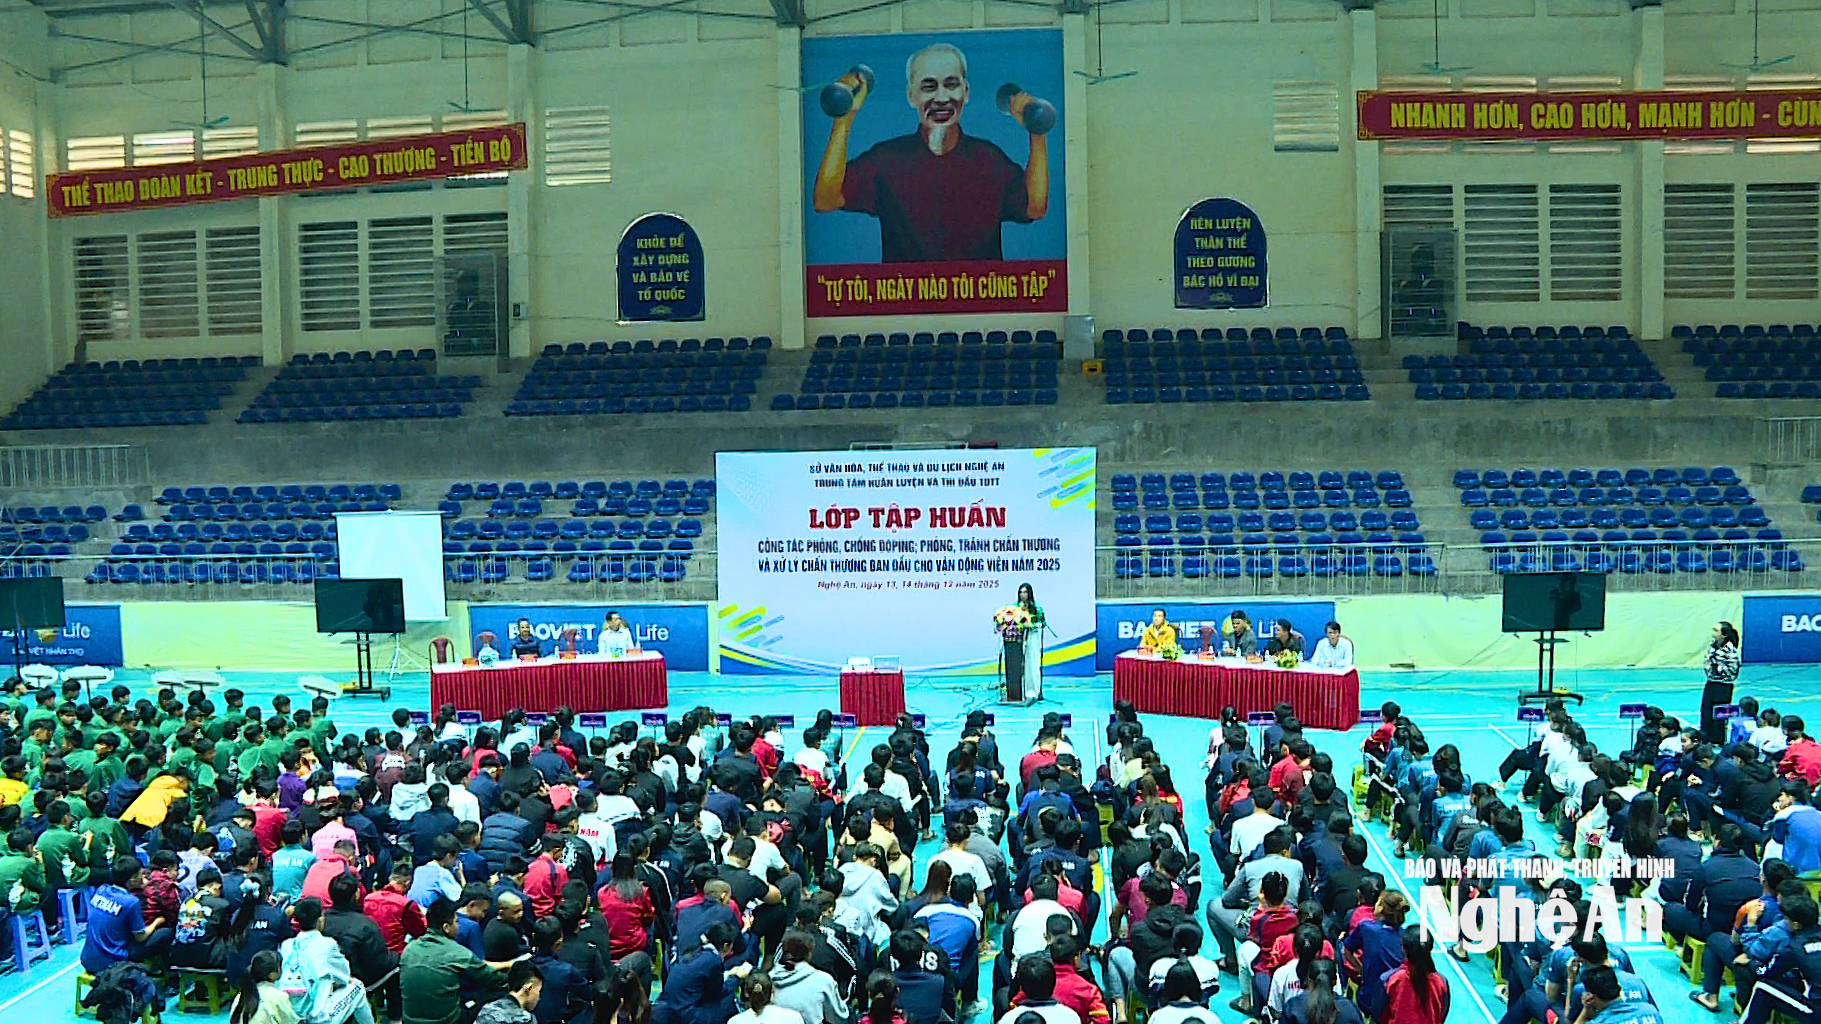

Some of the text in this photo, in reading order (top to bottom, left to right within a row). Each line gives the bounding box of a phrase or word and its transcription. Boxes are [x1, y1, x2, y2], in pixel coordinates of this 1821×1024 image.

[1390, 102, 1466, 129] NHANH
[1473, 100, 1524, 131] HƠN,
[1530, 102, 1574, 129] CAO
[1581, 99, 1632, 131] HƠN,
[1639, 102, 1702, 133] MẠNH
[1710, 98, 1755, 128] HƠN
[94, 180, 134, 204] THAO
[185, 167, 213, 195] KẾT
[228, 164, 278, 190] TRUNG
[281, 156, 324, 187] THỰC
[338, 155, 370, 178] CAO
[373, 146, 436, 176] THƯỢNG
[451, 135, 485, 167] TIẾN
[489, 134, 511, 165] BỘ
[1187, 256, 1214, 268] THEO
[846, 275, 873, 304] TÔI,
[876, 273, 914, 300] NGÀY
[918, 273, 948, 300] NÀO
[951, 270, 974, 300] TÔI
[978, 270, 1018, 299] CŨNG
[992, 461, 1005, 472] AN
[808, 498, 1006, 534] LỚP TẬP HUẤN
[758, 537, 784, 553] CÔNG
[786, 538, 804, 553] TÁC
[844, 536, 877, 553] CHỐNG
[958, 537, 991, 552] TRÁNH
[758, 557, 771, 573] VÀ
[830, 558, 867, 573] THƯƠNG
[869, 559, 890, 572] BAN
[914, 558, 933, 572] CHO
[936, 556, 955, 575] VẬN
[987, 556, 1009, 572] VIÊN
[1036, 558, 1061, 571] 2025
[902, 580, 912, 588] 14
[978, 579, 1000, 589] 2025
[636, 622, 669, 641] Life
